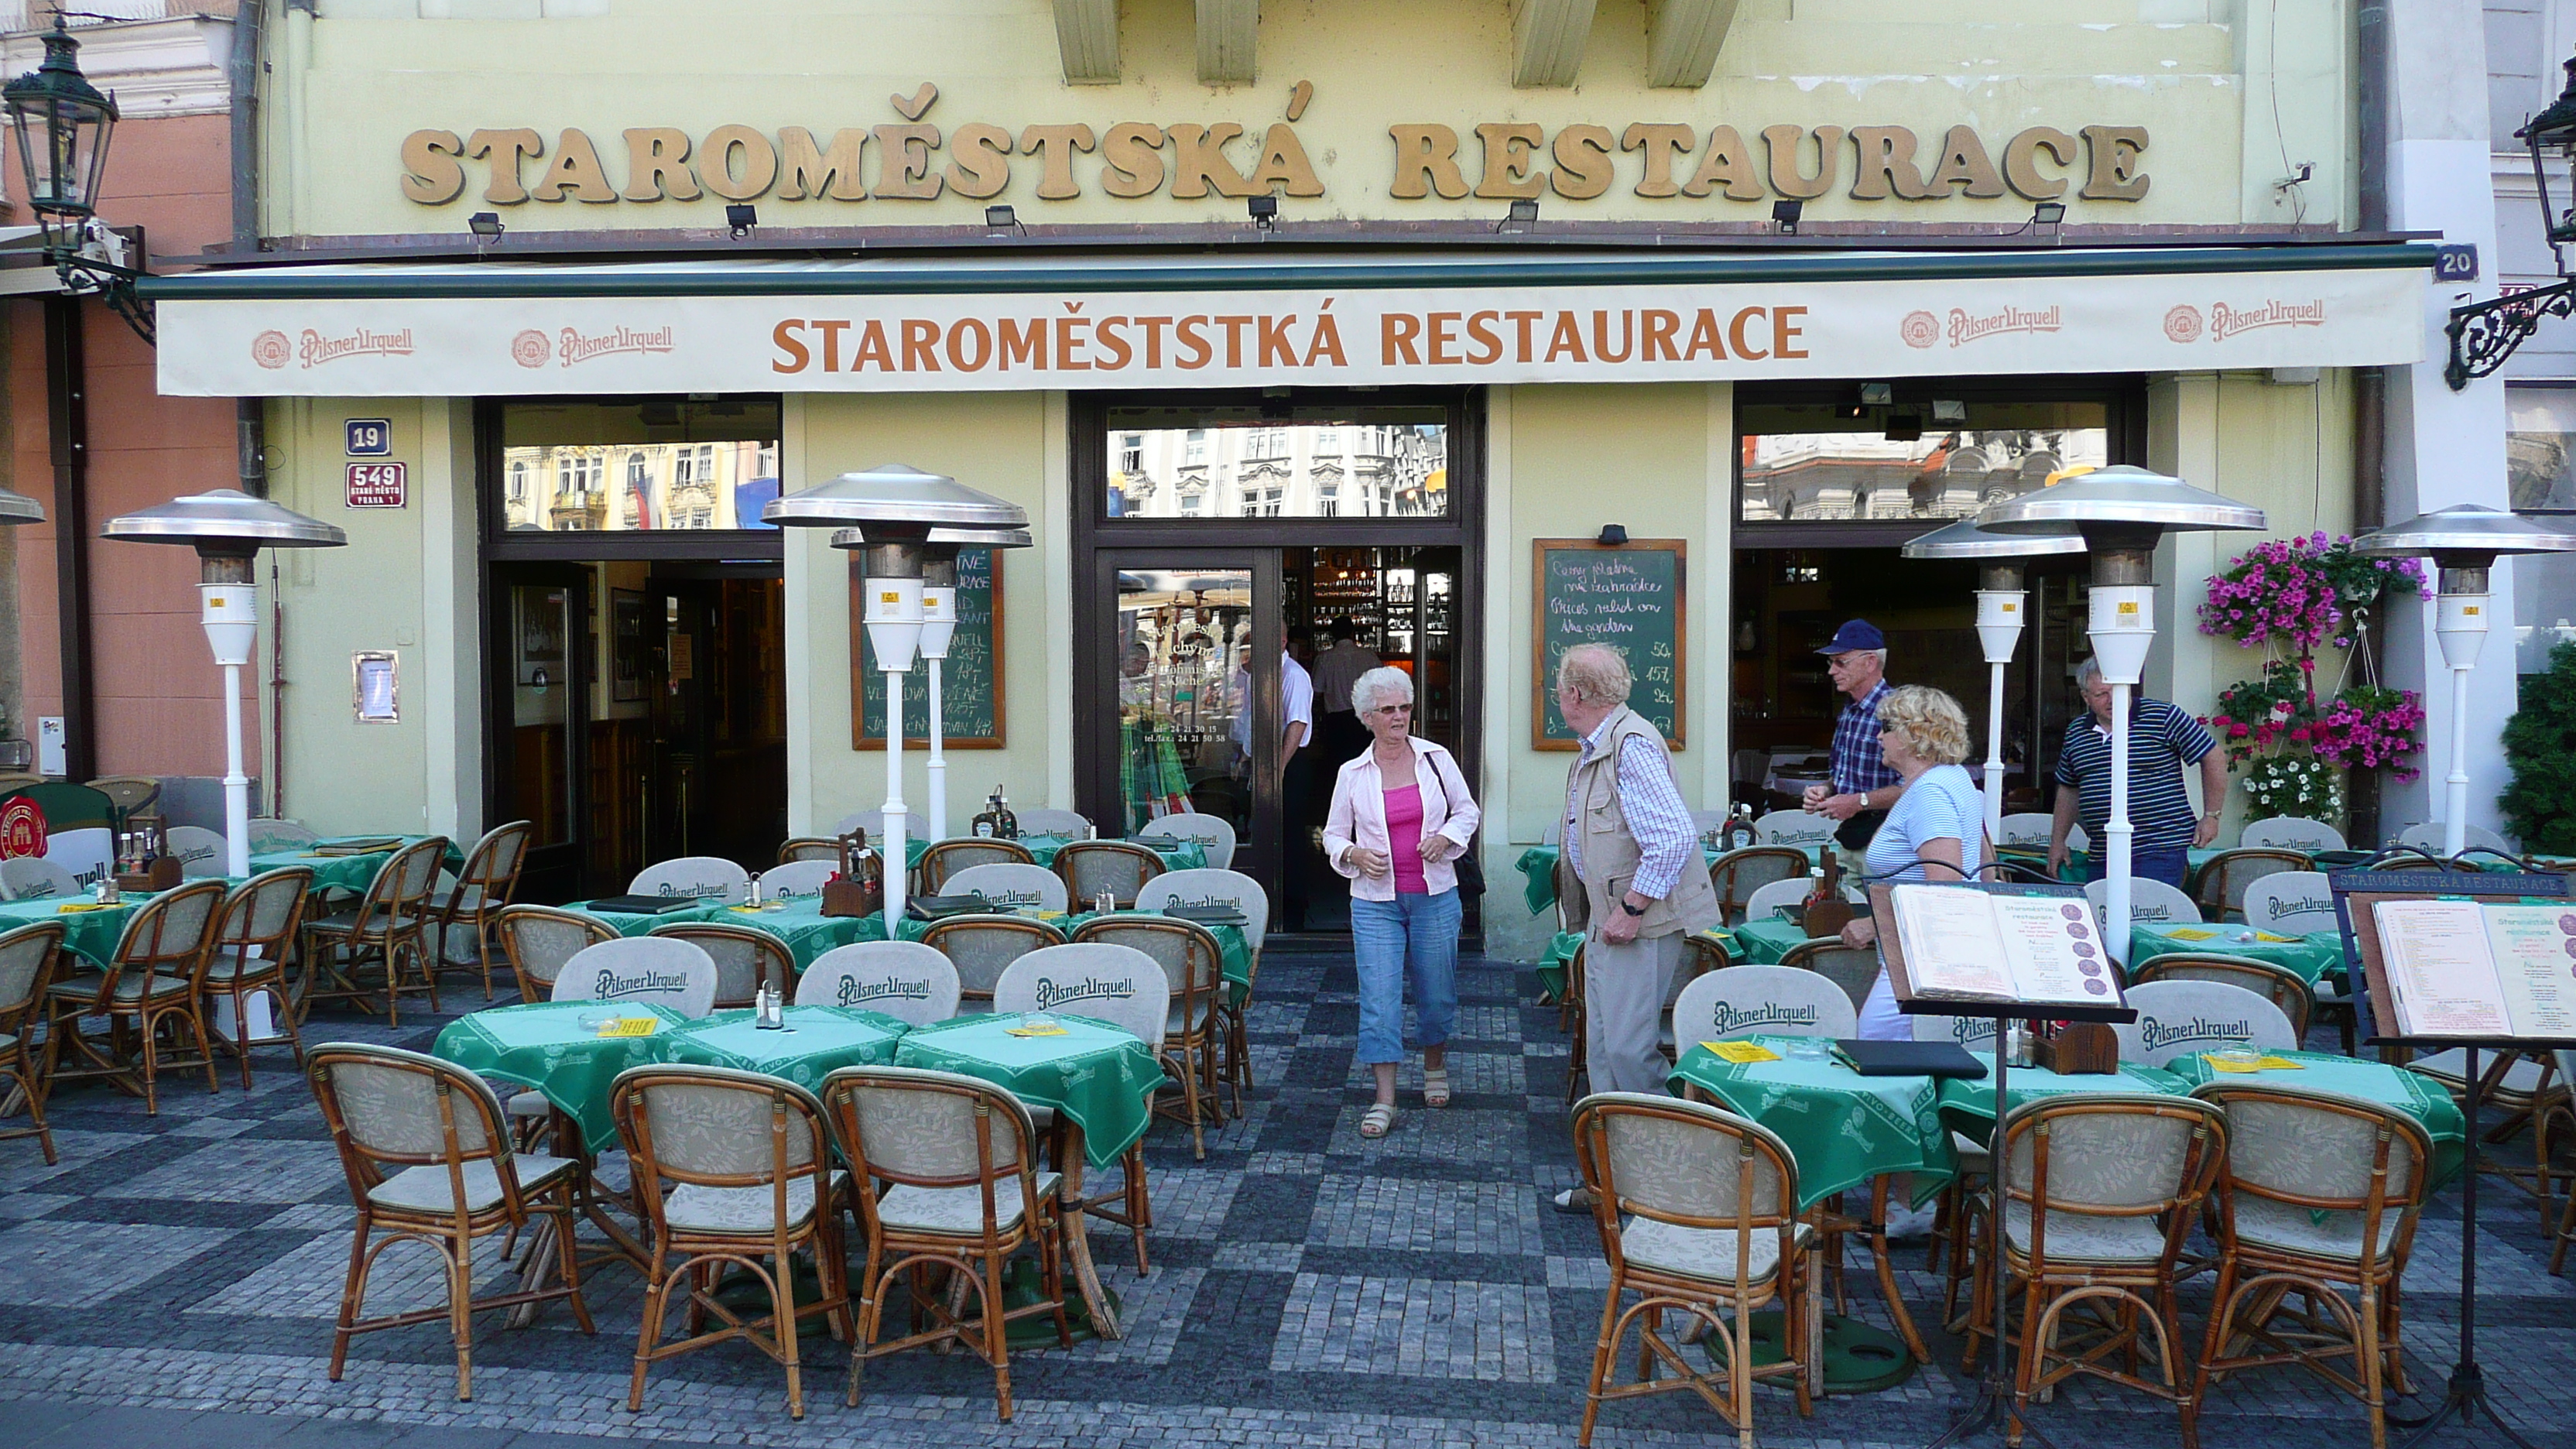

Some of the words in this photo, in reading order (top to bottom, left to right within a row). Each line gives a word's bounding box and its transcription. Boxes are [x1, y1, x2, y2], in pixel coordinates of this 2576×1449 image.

[400, 80, 1325, 205] STAROMĚSTSKÁ
[1389, 122, 2150, 203] RESTAURACE
[2442, 253, 2471, 272] 20
[1947, 307, 2005, 348] Pilsner
[2004, 304, 2060, 334] Urquell
[2211, 302, 2268, 342] Pilsner
[2267, 299, 2322, 327] Urquell
[299, 328, 358, 369] Pilsner
[356, 327, 412, 357] Urquell
[559, 327, 617, 368] Pilsner
[615, 325, 672, 355] Urquell
[772, 299, 1348, 373] STAROMĚSTSTKÁ
[1380, 305, 1810, 367] RESTAURACE
[355, 427, 378, 447] 19
[355, 467, 395, 485] 549
[1551, 597, 1588, 615] Prices
[1638, 603, 1661, 612] on
[1560, 618, 1583, 633] the
[1585, 618, 1632, 640] garden
[1797, 829, 1827, 842] Urquell
[696, 882, 728, 899] Urquell
[1007, 889, 1041, 907] Urquell
[2465, 876, 2558, 890] RESTAURACE
[2268, 896, 2305, 920] Pilsner
[2303, 896, 2335, 914] Urque
[595, 969, 647, 999] Pilsner
[646, 969, 687, 992] Urquell
[837, 974, 889, 1006] Pilsner
[887, 975, 930, 999] Urquell
[1036, 978, 1087, 1011] Pilsner
[1085, 976, 1132, 1001] Urquell
[1714, 1000, 1766, 1035] Pilsner
[1765, 1001, 1815, 1026] Urquell
[1953, 1016, 1996, 1044] Pilsne
[2143, 1016, 2194, 1052] Pilsner
[2192, 1016, 2249, 1041] Urquell
[1862, 1091, 1884, 1112] PIVO
[1888, 1112, 1914, 1135] BEER
